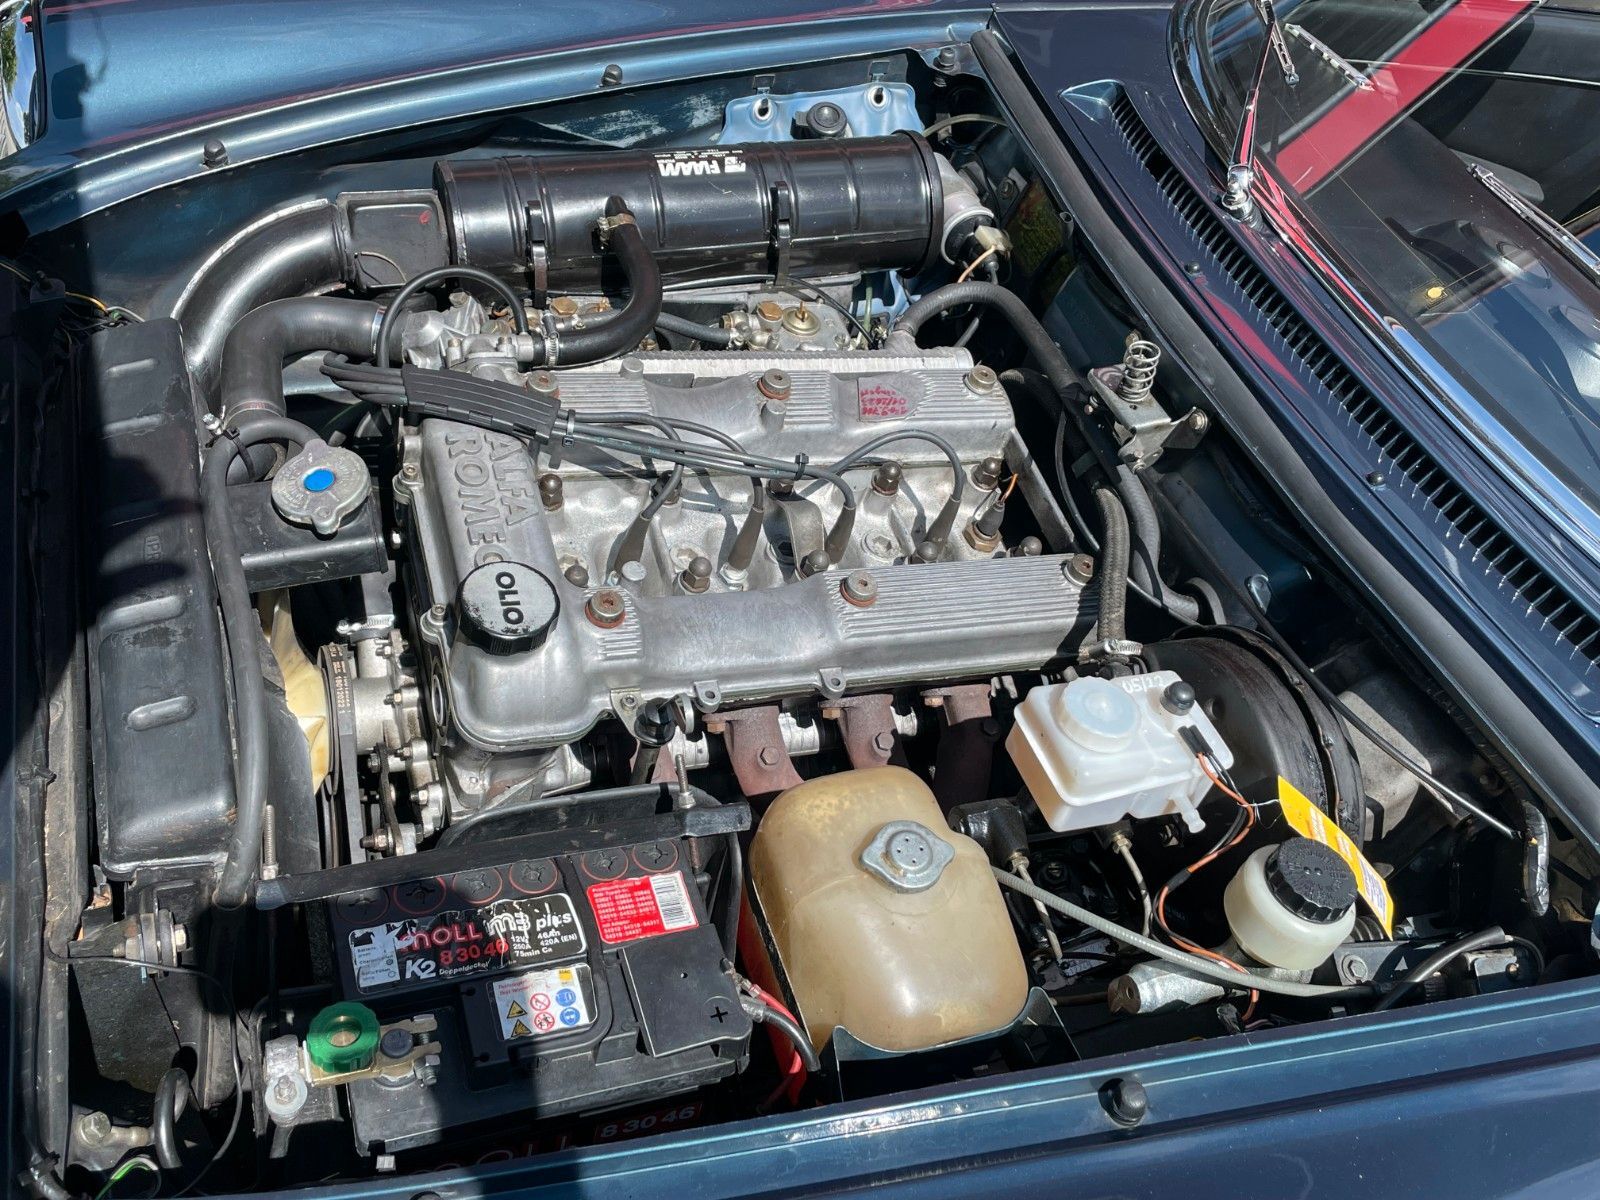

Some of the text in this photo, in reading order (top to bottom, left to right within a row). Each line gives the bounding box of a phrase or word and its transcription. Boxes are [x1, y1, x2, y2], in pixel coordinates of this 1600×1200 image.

[657, 160, 720, 176] FIAAM
[484, 434, 540, 526] ALFA
[495, 571, 524, 625] OLIO
[561, 934, 578, 944] (EN)
[439, 938, 509, 966] 8 30 46
[515, 949, 541, 958] 75min
[405, 957, 437, 980] K2
[601, 1106, 696, 1138] 8 30 46
